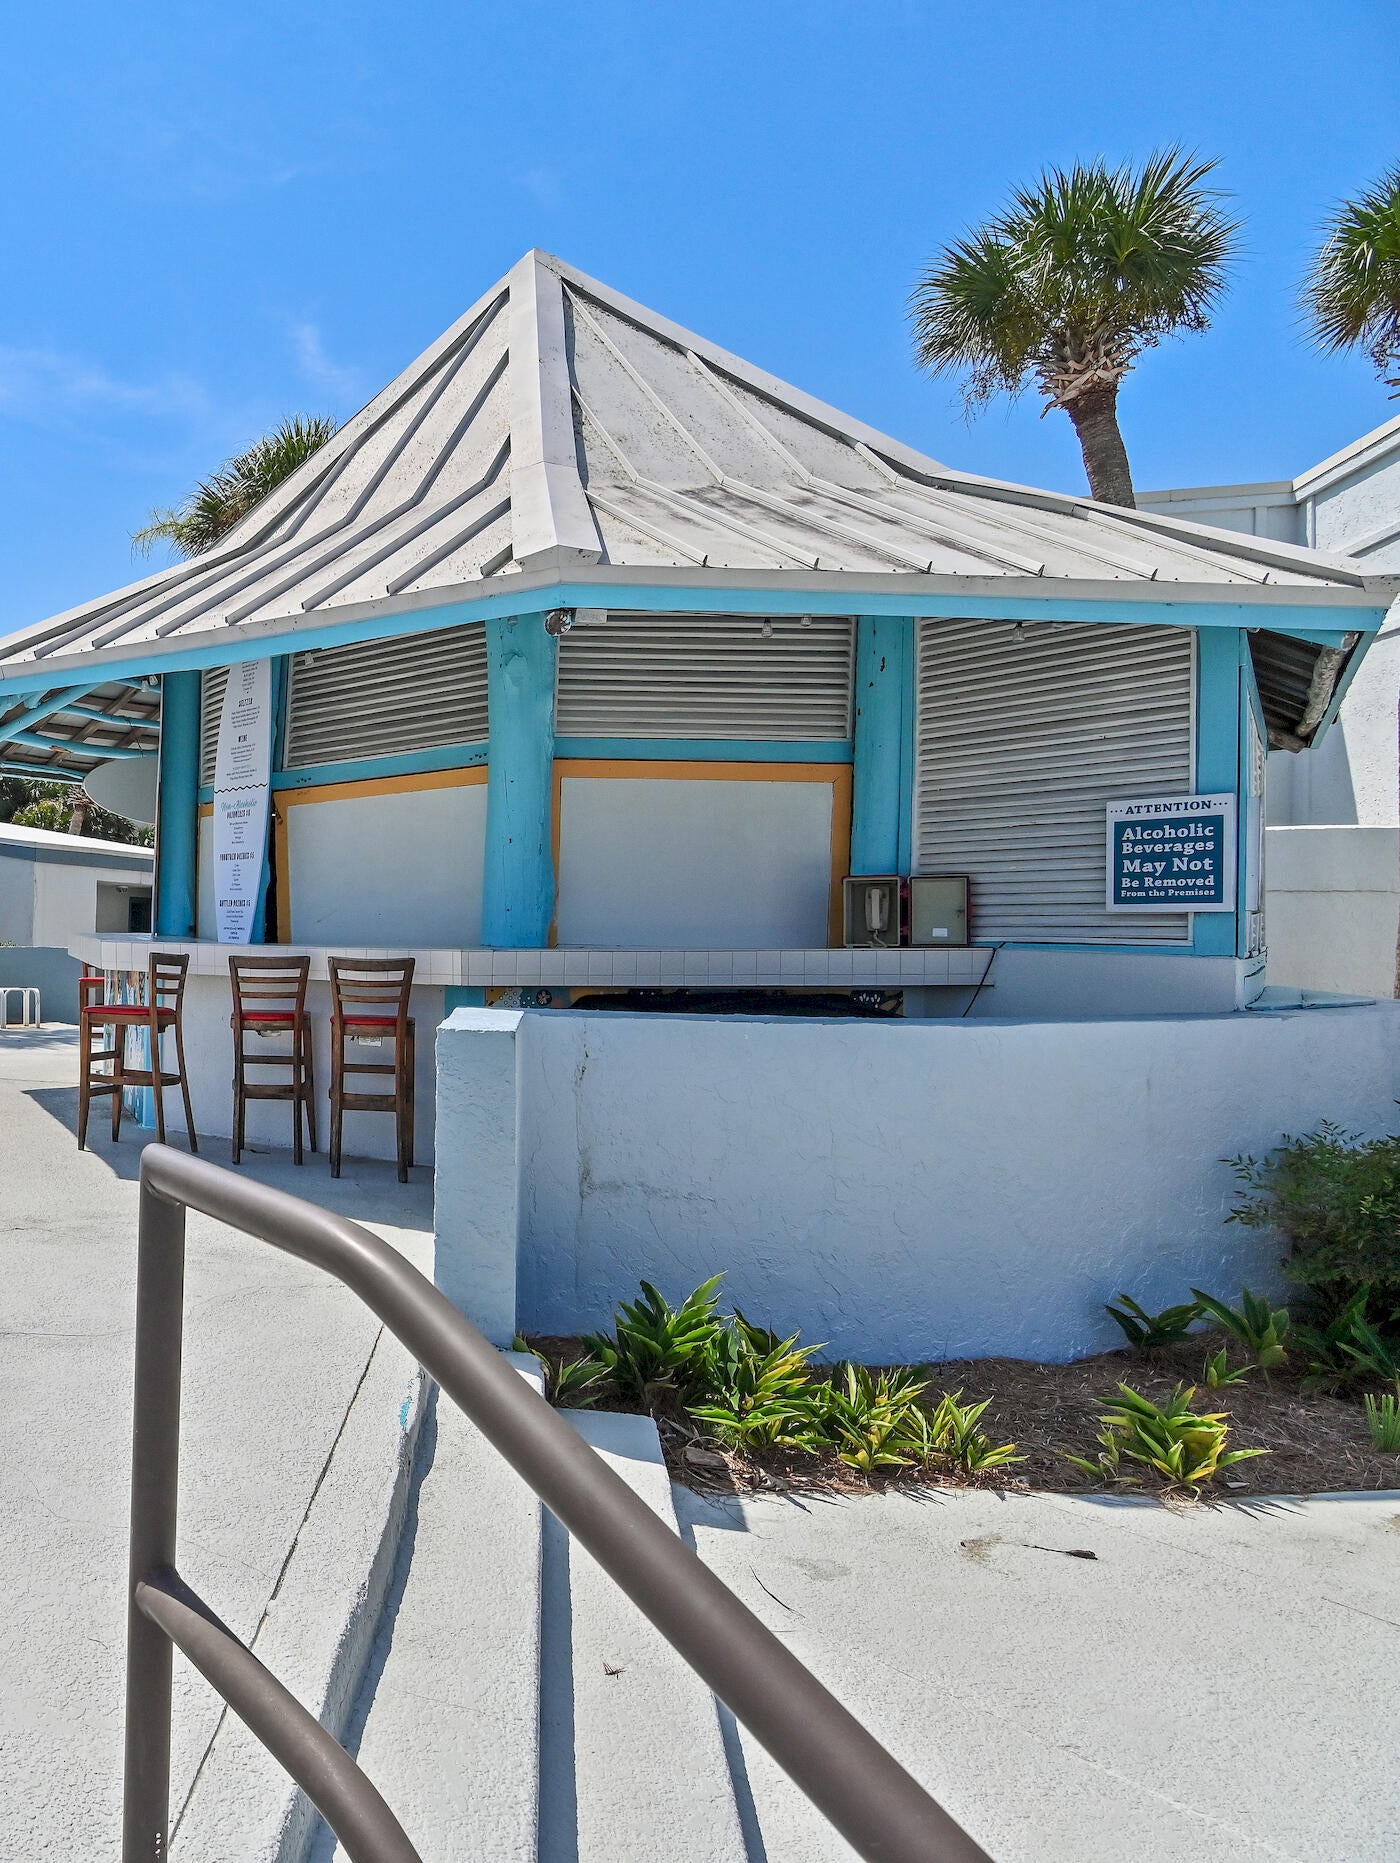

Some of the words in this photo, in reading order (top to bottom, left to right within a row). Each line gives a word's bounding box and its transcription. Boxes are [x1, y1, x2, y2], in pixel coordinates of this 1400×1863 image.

[1125, 800, 1212, 815] ATTENTION
[1121, 823, 1215, 841] Alcoholic
[1121, 841, 1215, 855] Beverages
[1122, 859, 1167, 876] May
[1172, 857, 1214, 872] Not
[1121, 877, 1140, 888] Be
[1144, 875, 1215, 887] Removed
[1148, 889, 1166, 897] the
[1168, 888, 1215, 897] Premises
